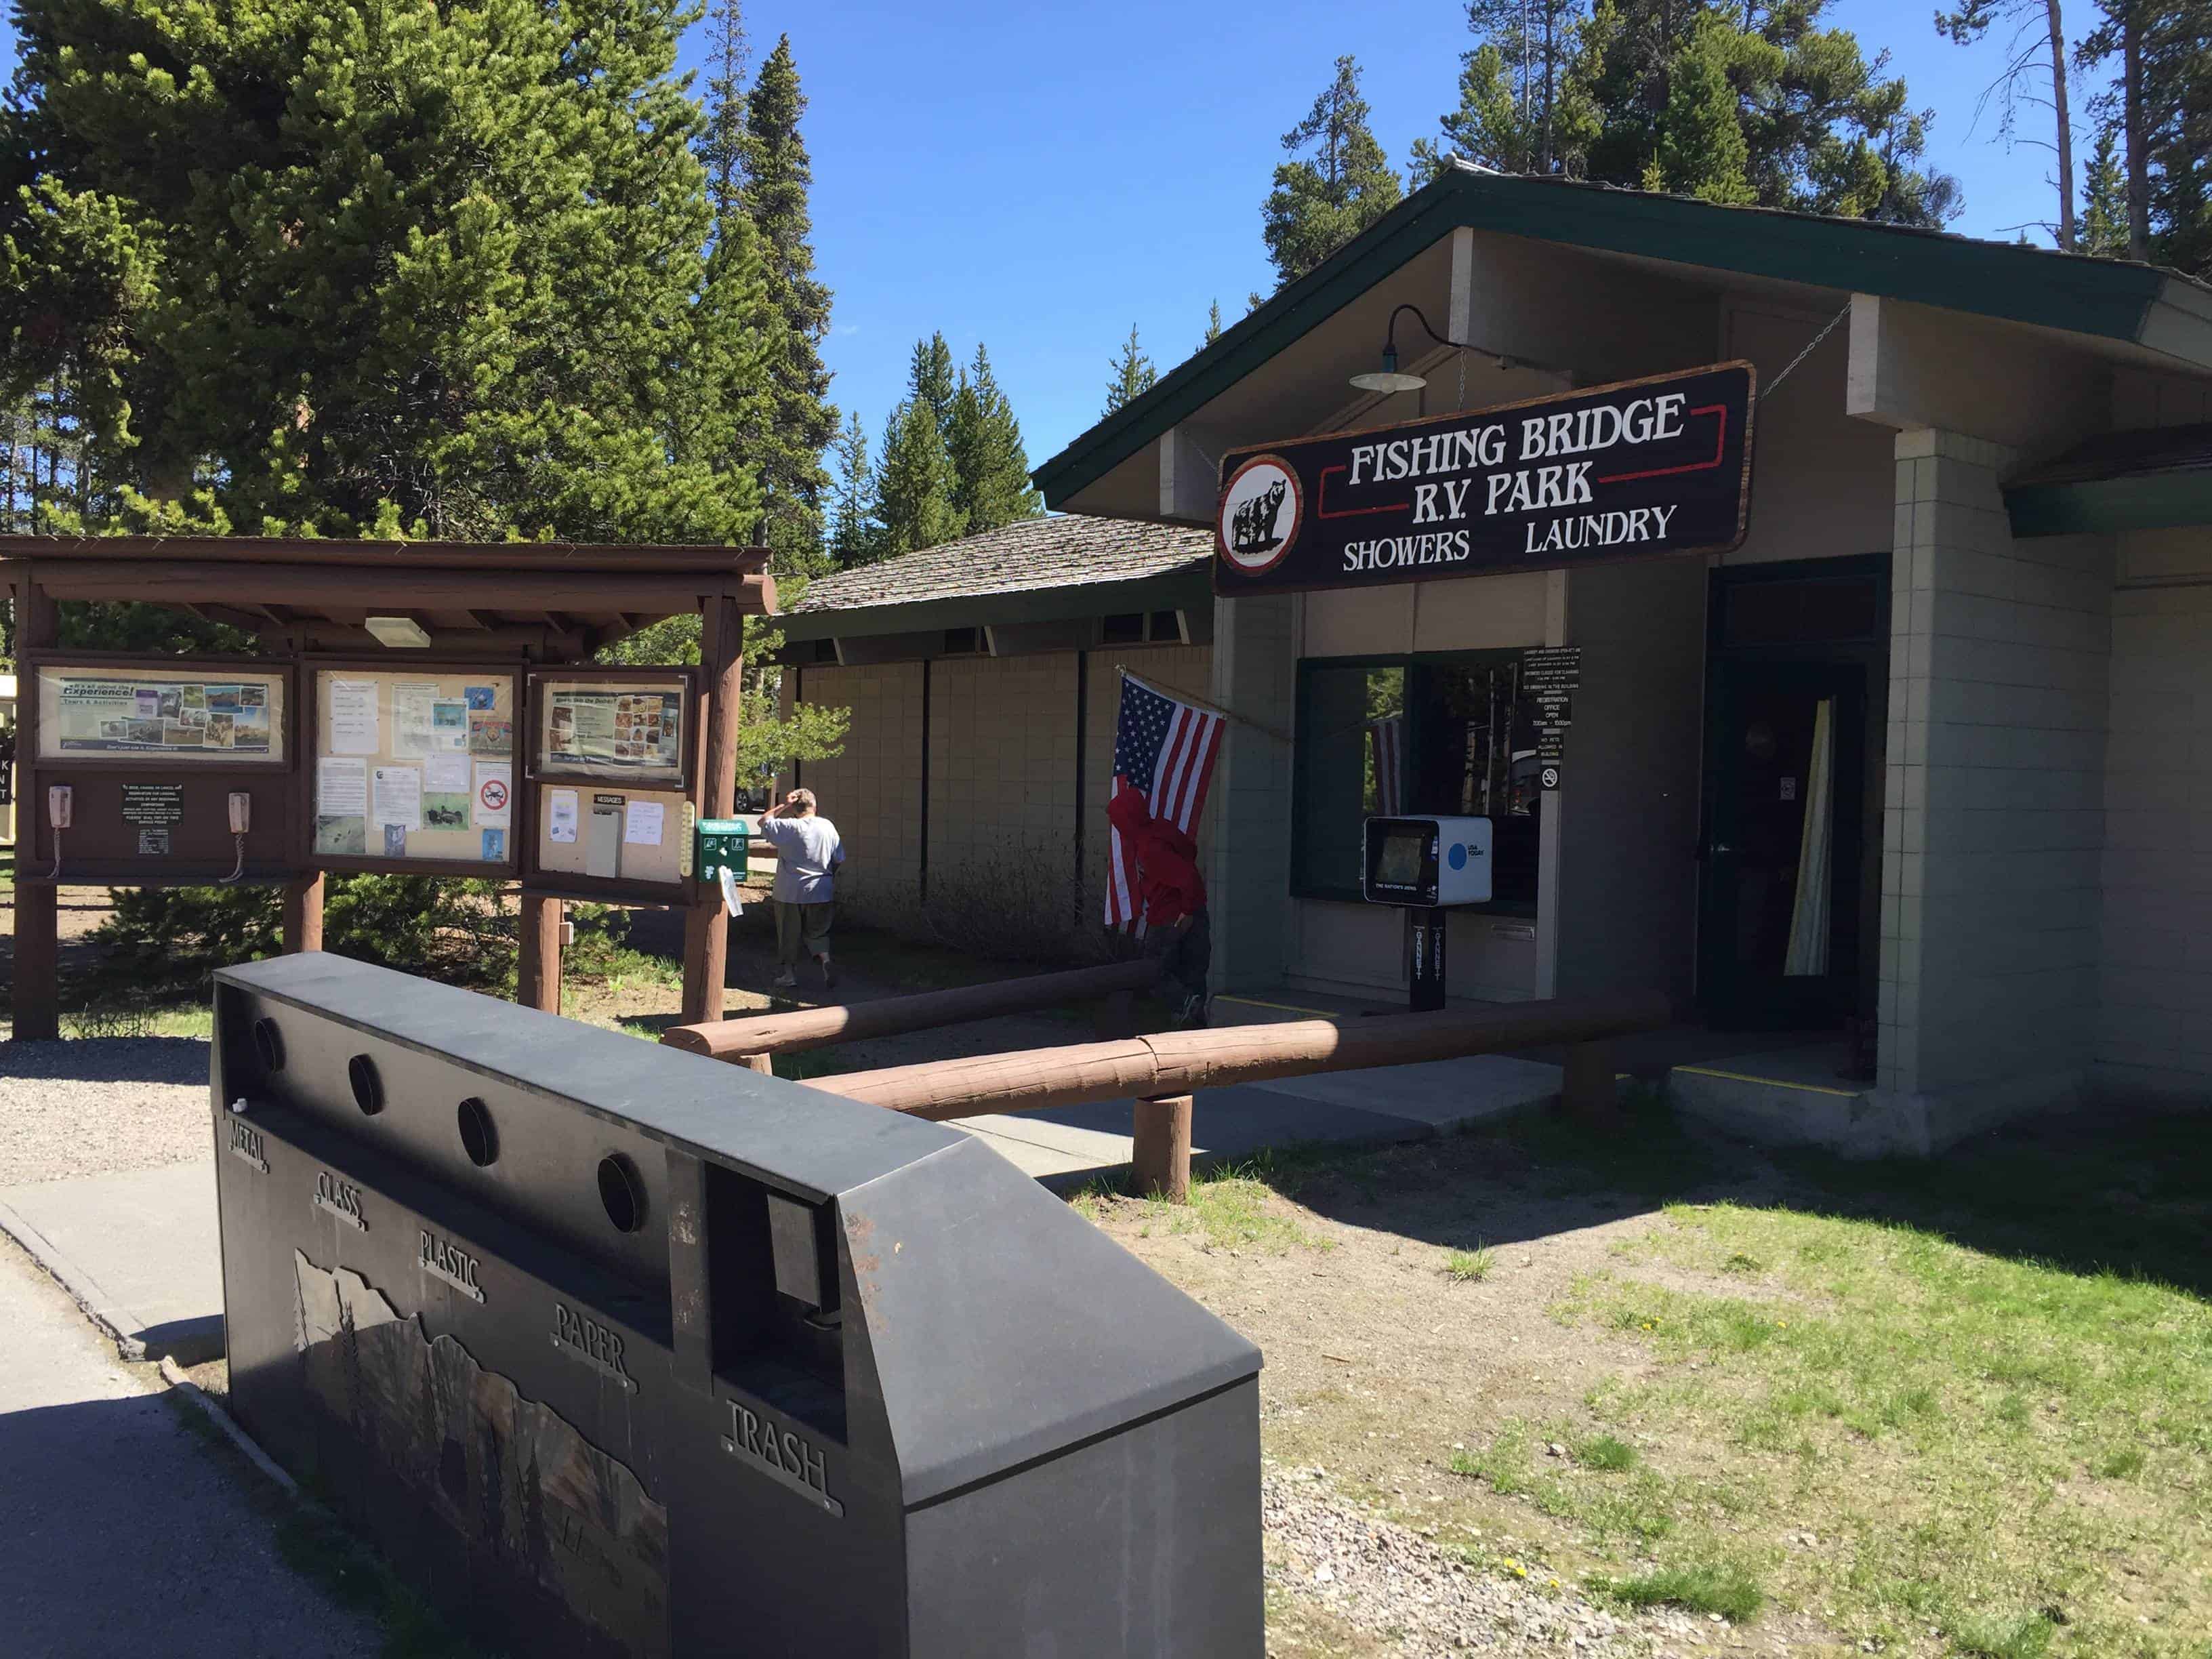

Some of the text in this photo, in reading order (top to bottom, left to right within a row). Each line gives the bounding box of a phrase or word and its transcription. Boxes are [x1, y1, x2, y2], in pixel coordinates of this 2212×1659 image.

[1349, 392, 1686, 485] FISHING BRIDGE
[1412, 461, 1593, 524] R.V. PARK
[1343, 530, 1470, 571] SHOWERS
[1525, 505, 1678, 554] LAUNDRY
[64, 687, 134, 697] Experience!
[597, 796, 623, 804] MESSAGES
[228, 1120, 265, 1162] METAL
[316, 1170, 363, 1218] GLASS
[419, 1229, 480, 1288] PLASTIC
[555, 1303, 629, 1378] PAPER
[726, 1399, 827, 1496] TRASH
